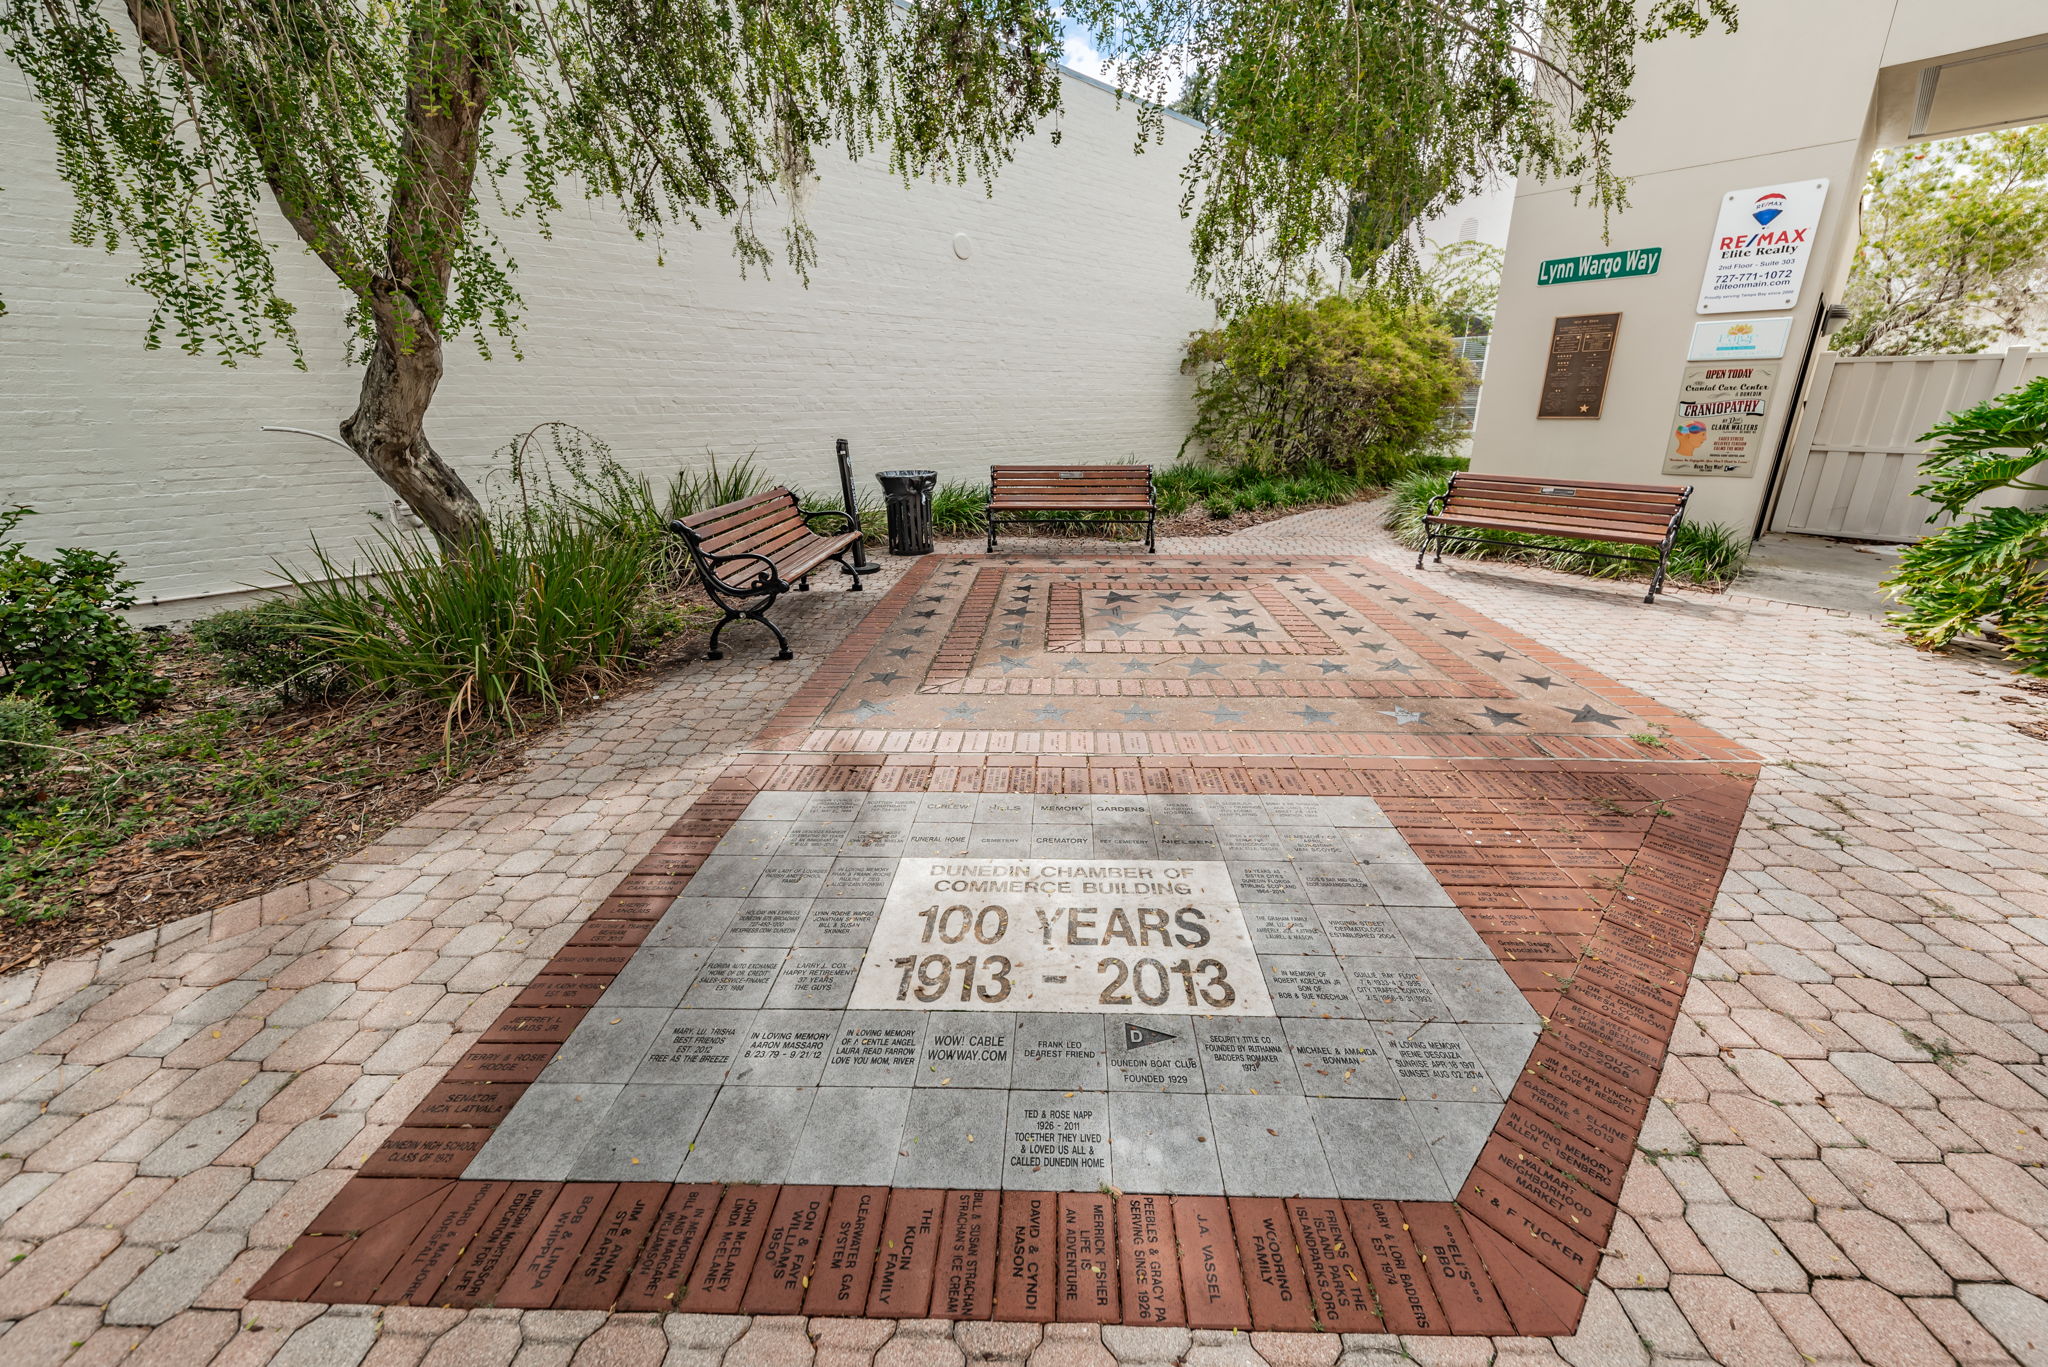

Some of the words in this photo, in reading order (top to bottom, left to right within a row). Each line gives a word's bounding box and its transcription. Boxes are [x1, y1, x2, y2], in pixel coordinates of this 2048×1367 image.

[1720, 228, 1807, 250] RE/MAX
[1721, 250, 1751, 259] Elite
[1756, 245, 1798, 255] Realty
[1540, 261, 1574, 284] Lynn
[1578, 256, 1621, 278] Wargo
[1626, 250, 1658, 273] Way
[1714, 279, 1790, 290] eliteonmain.com
[1715, 270, 1793, 283] 727-771-1072
[1706, 370, 1726, 379] OPEN
[1728, 369, 1753, 378] TODAY
[1684, 400, 1760, 416] CRANIOPATHY
[930, 865, 1029, 879] DUNEDIN
[1040, 866, 1153, 879] CHAMBER
[1164, 867, 1194, 879] OF
[934, 880, 1072, 894] COMMERCE
[1082, 881, 1192, 896] BUILDING
[918, 904, 1009, 945] 100
[1035, 907, 1211, 948] YEARS
[894, 954, 1012, 1003] 1913
[1042, 975, 1067, 984] -
[1097, 957, 1236, 1007] 2013
[934, 1035, 965, 1046] WOW!
[969, 1036, 1005, 1047] CABLE
[1131, 1030, 1143, 1043] D
[1210, 1035, 1241, 1043] SECURITY
[1261, 1036, 1273, 1044] CO.
[751, 1041, 782, 1049] AARON
[784, 1041, 823, 1049] MASSARO
[1038, 1041, 1064, 1049] FRANK
[1067, 1041, 1082, 1049] LEO
[1205, 1044, 1236, 1052] FOUNDED
[1248, 1045, 1282, 1053] RUTHANNA
[1297, 1047, 1332, 1055] MICHAEL
[1344, 1048, 1378, 1056] AMANDA
[744, 1051, 779, 1059] 8/23/79
[790, 1051, 822, 1059] 9/21/12
[928, 1049, 1008, 1062] WOWWAY.COM
[1024, 1050, 1064, 1058] DEAREST
[1066, 1050, 1095, 1058] FRIEND
[1214, 1054, 1244, 1062] BADDERS
[1246, 1054, 1279, 1063] ROMAKER
[1323, 1057, 1360, 1065] BOWMAN
[1111, 1059, 1147, 1068] DUNEDIN
[1151, 1060, 1172, 1068] BOAT
[1175, 1060, 1197, 1069] CLUB
[1242, 1063, 1257, 1072] 1973
[1124, 1074, 1165, 1083] FOUNDED
[1169, 1075, 1188, 1084] 1929
[447, 1094, 497, 1102] SENATOR
[1024, 1109, 1039, 1119] TED
[1041, 1110, 1047, 1119] &
[1050, 1110, 1070, 1119] ROSE
[1074, 1110, 1093, 1119] NAPP
[1037, 1121, 1055, 1130] 1926
[1064, 1122, 1080, 1131] 2011
[1015, 1132, 1055, 1142] TOGETHER
[1058, 1133, 1077, 1143] THEY
[1080, 1133, 1102, 1143] LIVED
[1511, 1112, 1521, 1122] IN
[1524, 1120, 1561, 1147] LOVING
[1565, 1144, 1614, 1175] MEMORY
[1021, 1145, 1026, 1154] &
[1029, 1144, 1056, 1154] LOVED
[1058, 1145, 1069, 1154] US
[1072, 1145, 1085, 1154] ALL
[1089, 1145, 1095, 1155] &
[1506, 1120, 1538, 1146] ALLEN
[1542, 1141, 1550, 1151] C.
[1555, 1151, 1611, 1186] ISENBERG
[1010, 1156, 1040, 1166] CALLED
[1043, 1157, 1079, 1167] DUNEDIN
[1081, 1157, 1105, 1168] HOME
[1521, 1158, 1577, 1194] WALMART
[1498, 1154, 1593, 1217] NEIGHBORHOOD
[1516, 1177, 1566, 1210] MARKET
[920, 1208, 933, 1234] THE
[1028, 1200, 1040, 1238] DAVID
[1066, 1209, 1076, 1225] AN
[845, 1195, 871, 1268] CLEARWATER
[1093, 1205, 1106, 1255] MERRICK
[1491, 1198, 1500, 1208] &
[1507, 1208, 1517, 1216] F
[1522, 1217, 1584, 1265] TUCKER
[831, 1222, 851, 1268] SYSTEM
[900, 1226, 916, 1270] KUCIN
[1080, 1230, 1091, 1256] LIFE
[1013, 1226, 1025, 1278] NASON
[1263, 1218, 1292, 1301] WOODRING
[1066, 1230, 1077, 1300] ADVENTURE
[1081, 1260, 1091, 1270] IS
[1252, 1236, 1274, 1286] FAMILY
[880, 1254, 898, 1304] FAMILY
[1202, 1245, 1221, 1304] VASSEL
[838, 1274, 853, 1300] GAS
[1026, 1262, 1039, 1310] CYNDI
[1095, 1261, 1108, 1306] FISHER
